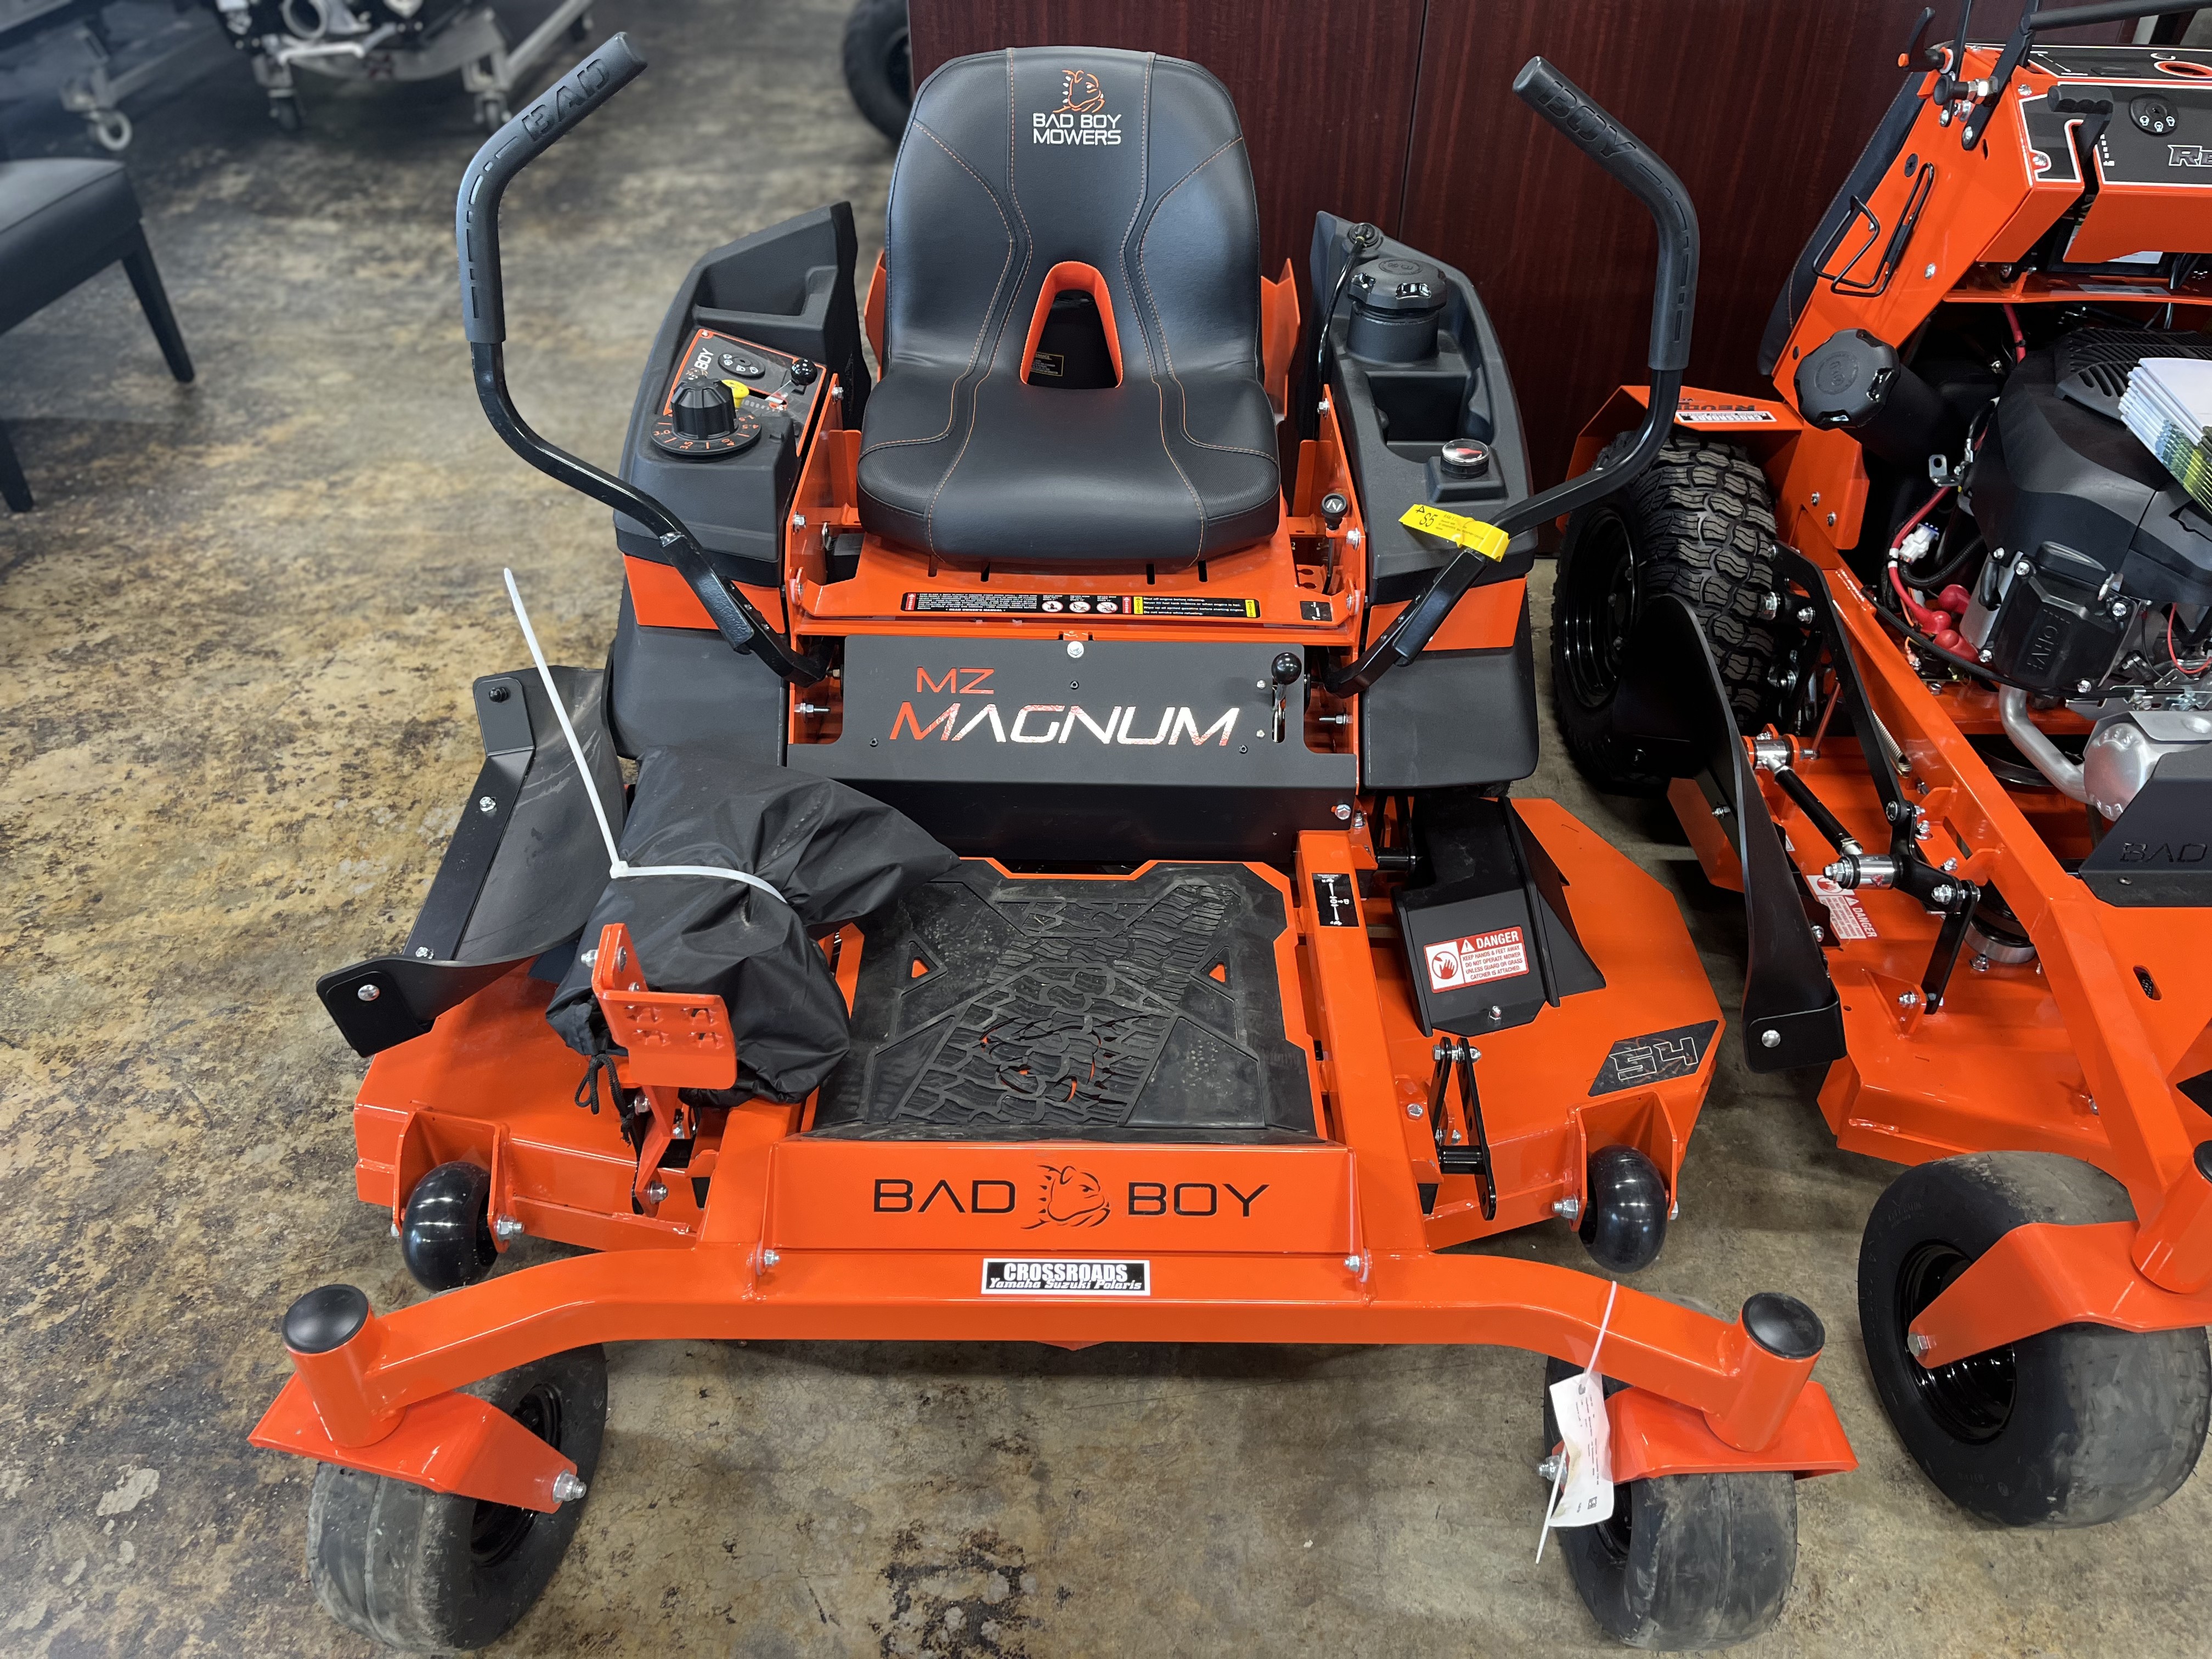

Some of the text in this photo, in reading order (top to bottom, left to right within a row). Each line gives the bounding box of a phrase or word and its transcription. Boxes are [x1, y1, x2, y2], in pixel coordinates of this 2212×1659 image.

[522, 64, 610, 142] BAD
[1033, 113, 1122, 129] BAD BOY
[1538, 81, 1636, 158] BOY
[1033, 128, 1121, 145] MOWERS
[694, 347, 714, 370] BOY
[916, 666, 995, 695] MZ
[889, 701, 1240, 747] MAGNUM
[2119, 843, 2208, 862] BAD
[1852, 907, 1877, 938] DANGER
[1476, 930, 1519, 949] DANGER
[1483, 956, 1503, 964] OPERATE
[1466, 966, 1483, 974] UNLESS
[1470, 971, 1491, 980] CATCHER
[1497, 965, 1521, 974] ATTACHED.
[1609, 1036, 1699, 1081] 54
[873, 1177, 1271, 1218] BAD BOY
[1003, 1263, 1128, 1282] CROSSROADS
[989, 1277, 1142, 1290] Yamaha Suzuki Polaris
